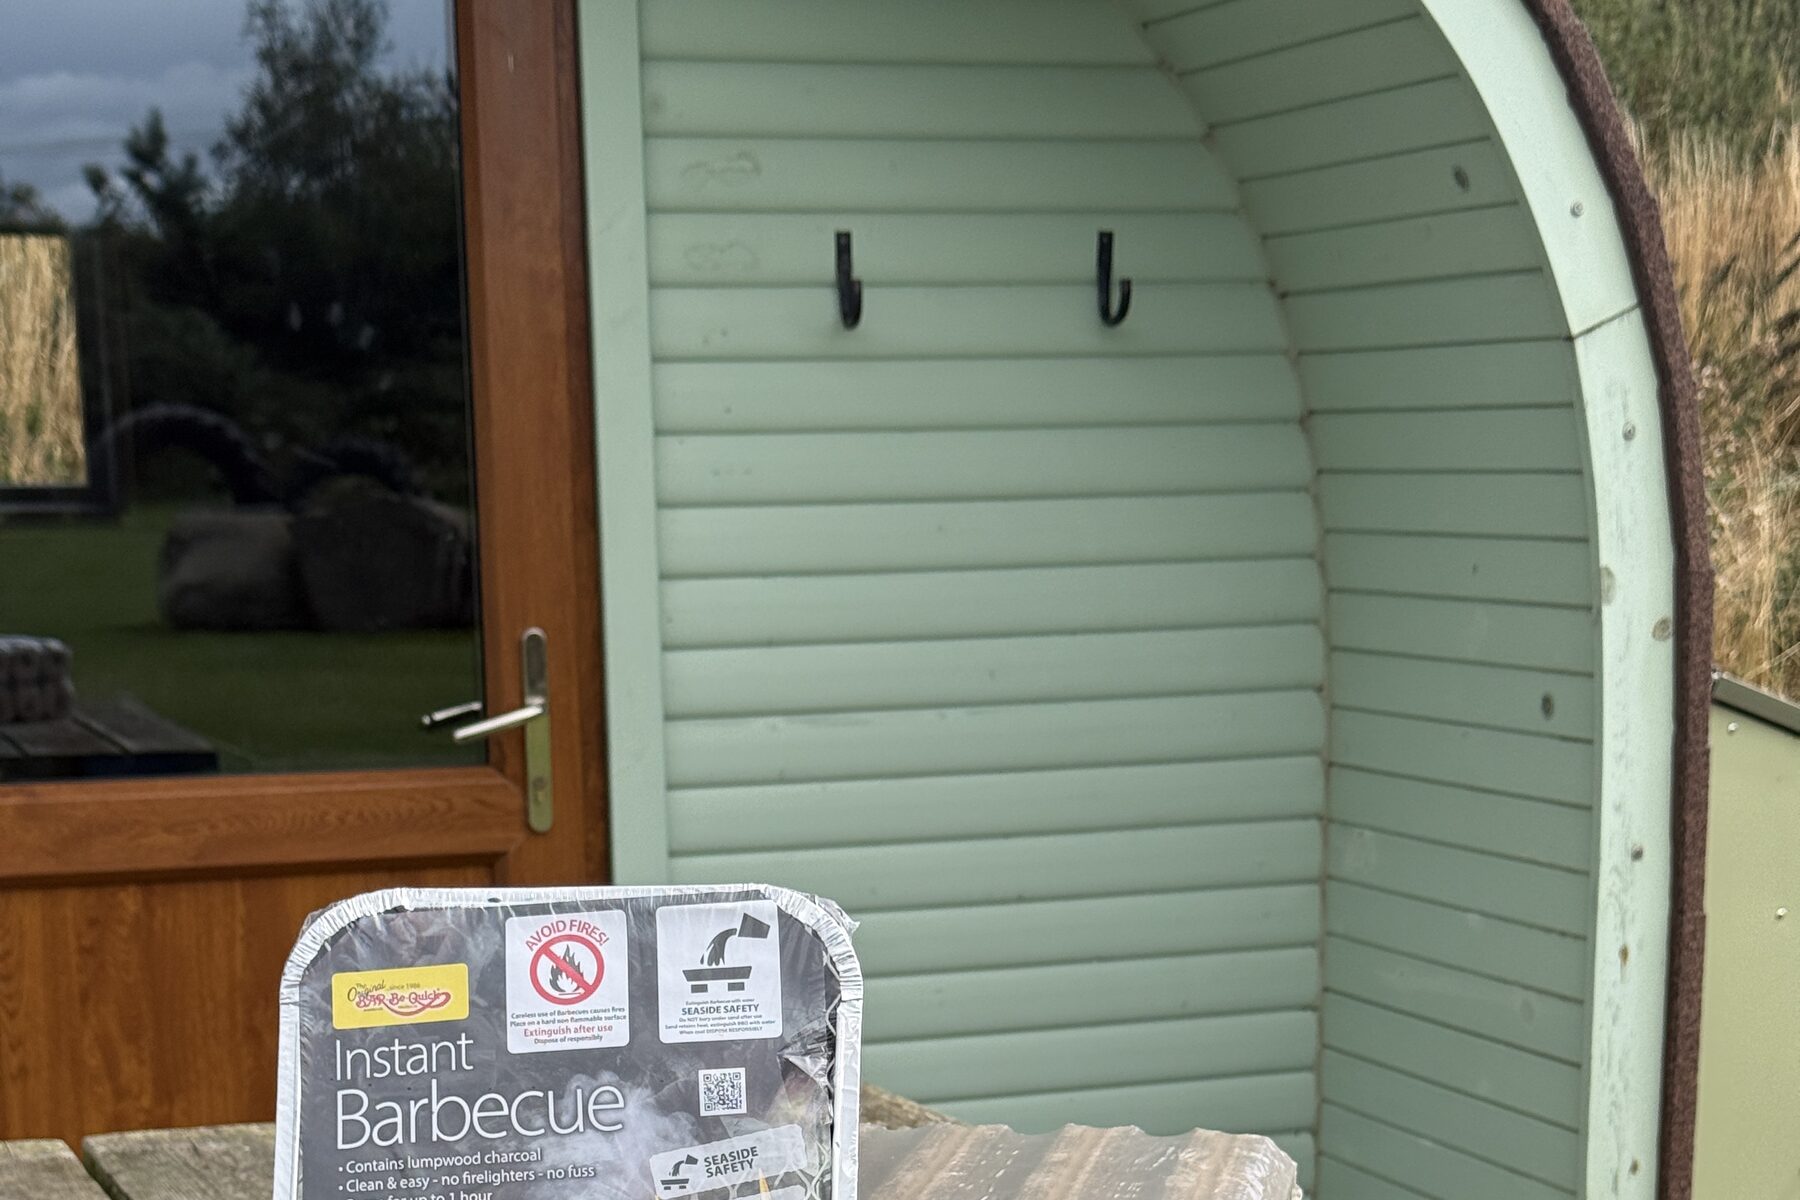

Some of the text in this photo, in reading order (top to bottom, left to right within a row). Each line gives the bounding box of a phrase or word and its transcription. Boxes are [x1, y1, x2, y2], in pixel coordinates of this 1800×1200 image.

[525, 919, 610, 951] AVOID FIRES!
[511, 1010, 536, 1019] Careless
[557, 1008, 589, 1016] Barbecues
[541, 1017, 556, 1025] hard
[604, 1013, 627, 1021] surface
[681, 1003, 760, 1016] SEASIDE SAFETY
[523, 1024, 613, 1038] Extinguish after use
[534, 1034, 603, 1045] Dispose of responsibly
[335, 1032, 474, 1081] Instant
[335, 1078, 625, 1150] Barbecue
[346, 1148, 542, 1174] Contains lumpwood charcoal
[703, 1146, 759, 1168] SEASIDE
[346, 1178, 384, 1193] Clean
[387, 1176, 397, 1190] &
[400, 1176, 430, 1192] easy
[441, 1173, 460, 1187] no
[462, 1166, 535, 1186] firelighters
[546, 1166, 565, 1180] no
[567, 1163, 596, 1179] fuss
[706, 1158, 755, 1179] SAFETY
